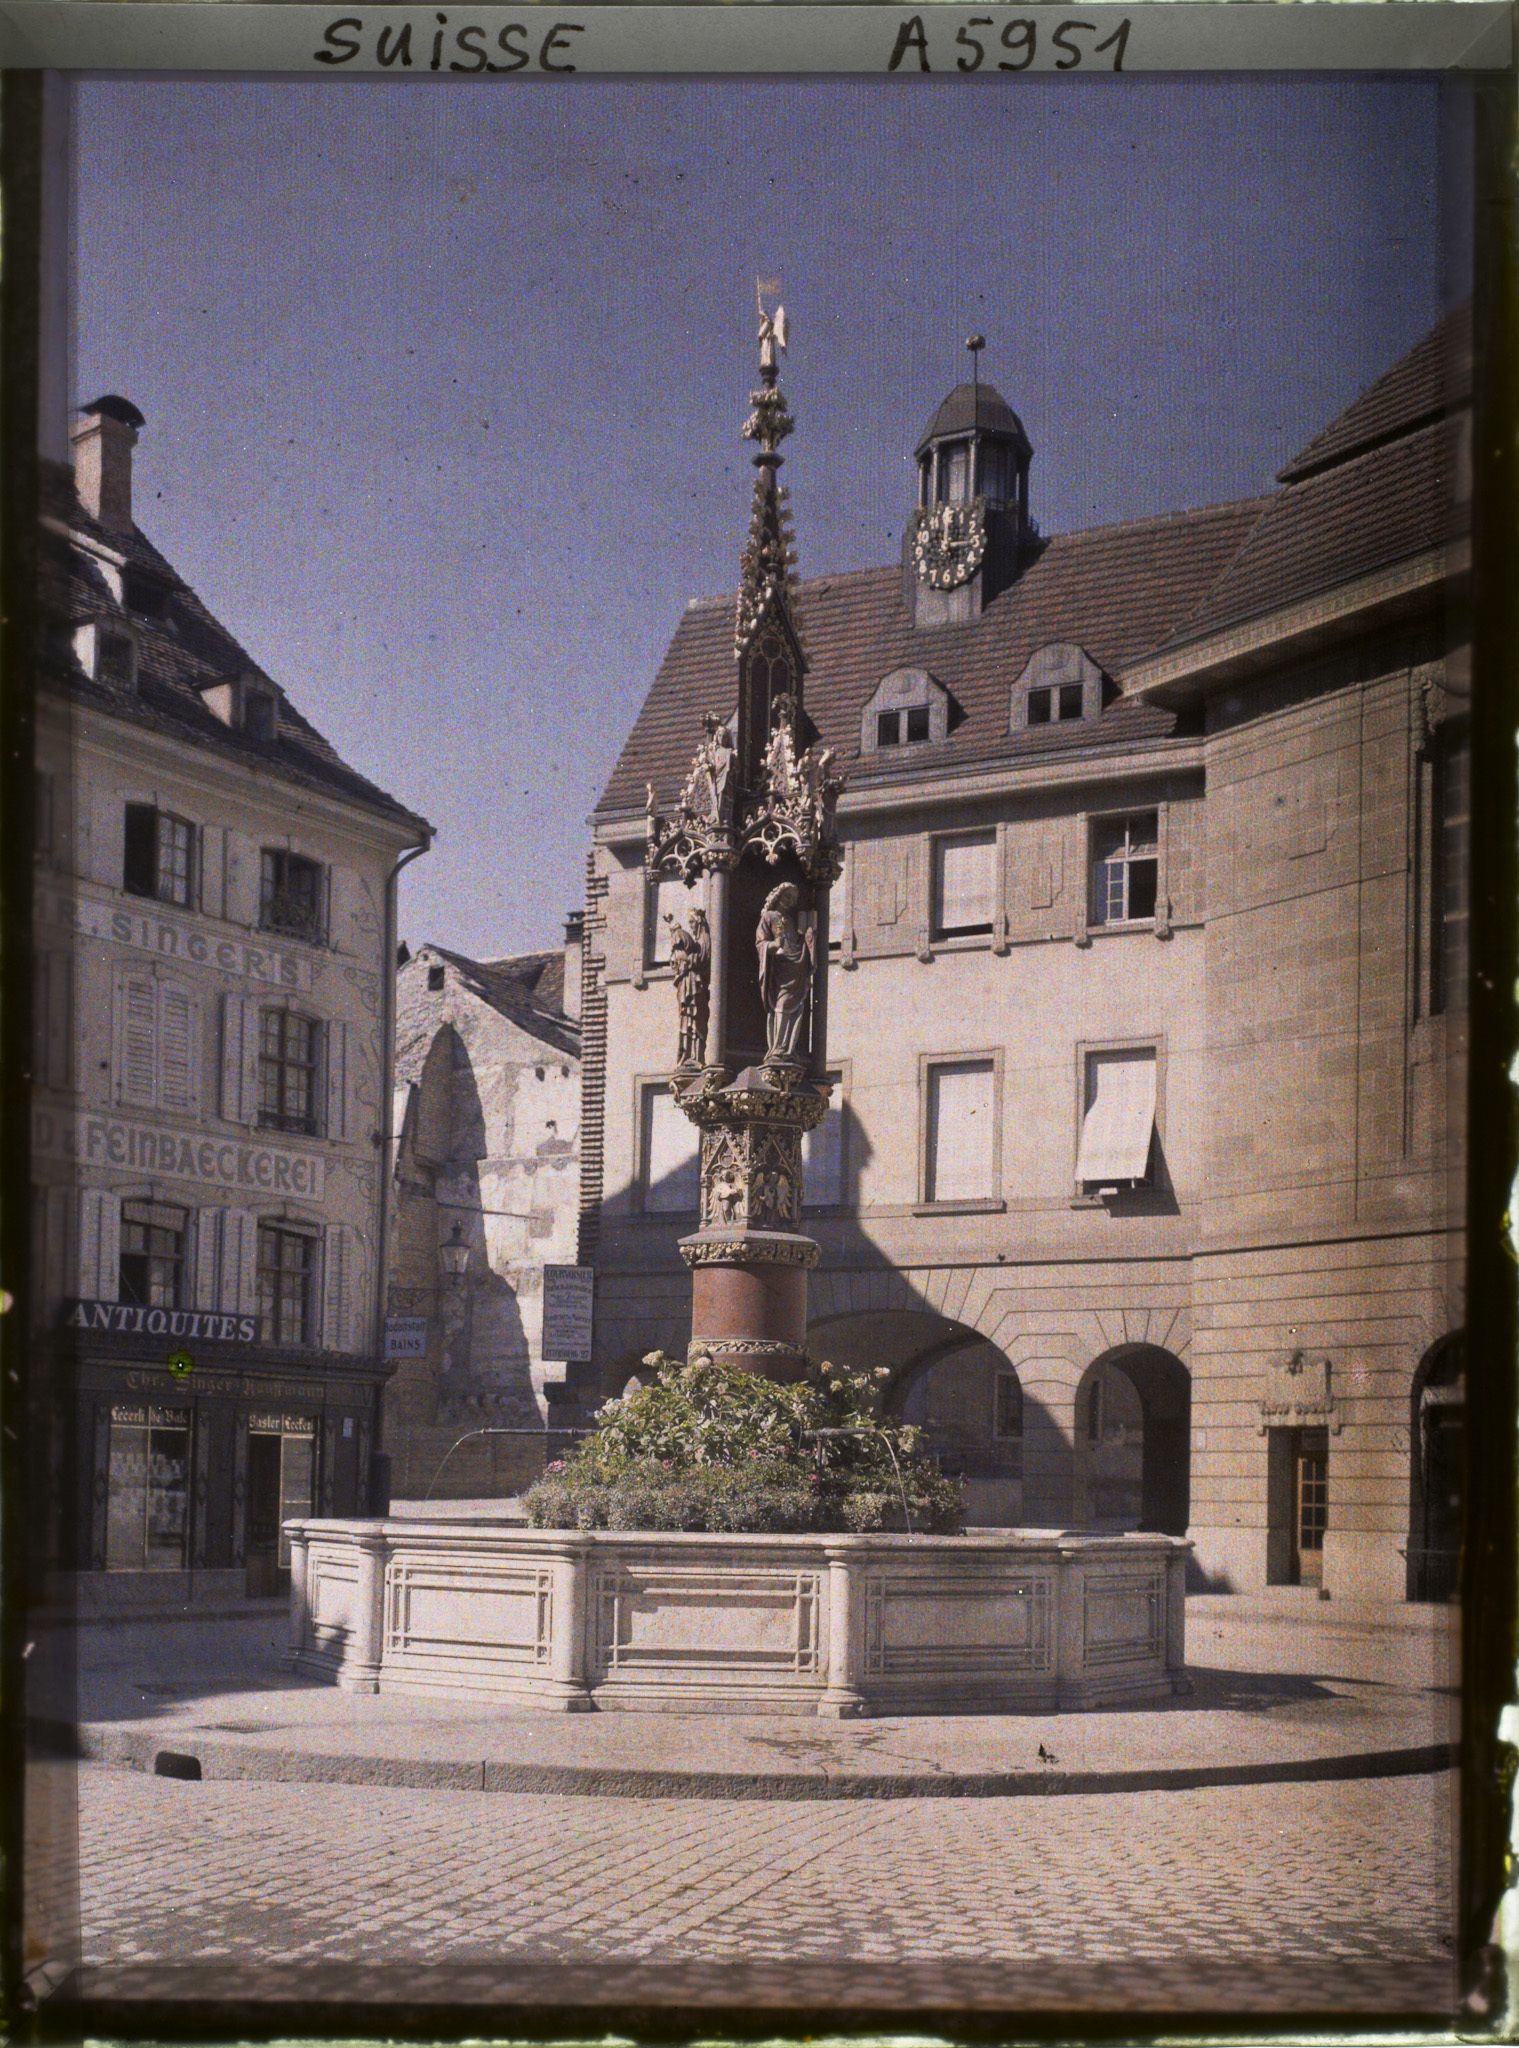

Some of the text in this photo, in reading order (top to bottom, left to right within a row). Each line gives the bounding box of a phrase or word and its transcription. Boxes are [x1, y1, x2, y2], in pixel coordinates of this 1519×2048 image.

[929, 516, 939, 529] 11
[959, 512, 964, 524] 1
[968, 521, 976, 533] 2
[917, 530, 929, 543] 10
[972, 535, 980, 547] 3
[915, 546, 923, 559] 9
[967, 551, 976, 563] 4
[919, 560, 927, 573] 8
[957, 564, 965, 577] 5
[929, 569, 937, 582] 7
[942, 569, 950, 583] 6
[86, 1120, 316, 1194] FEINBAECKEREI
[66, 1302, 256, 1343] ANTIQUITES
[391, 1339, 421, 1350] BAINS
